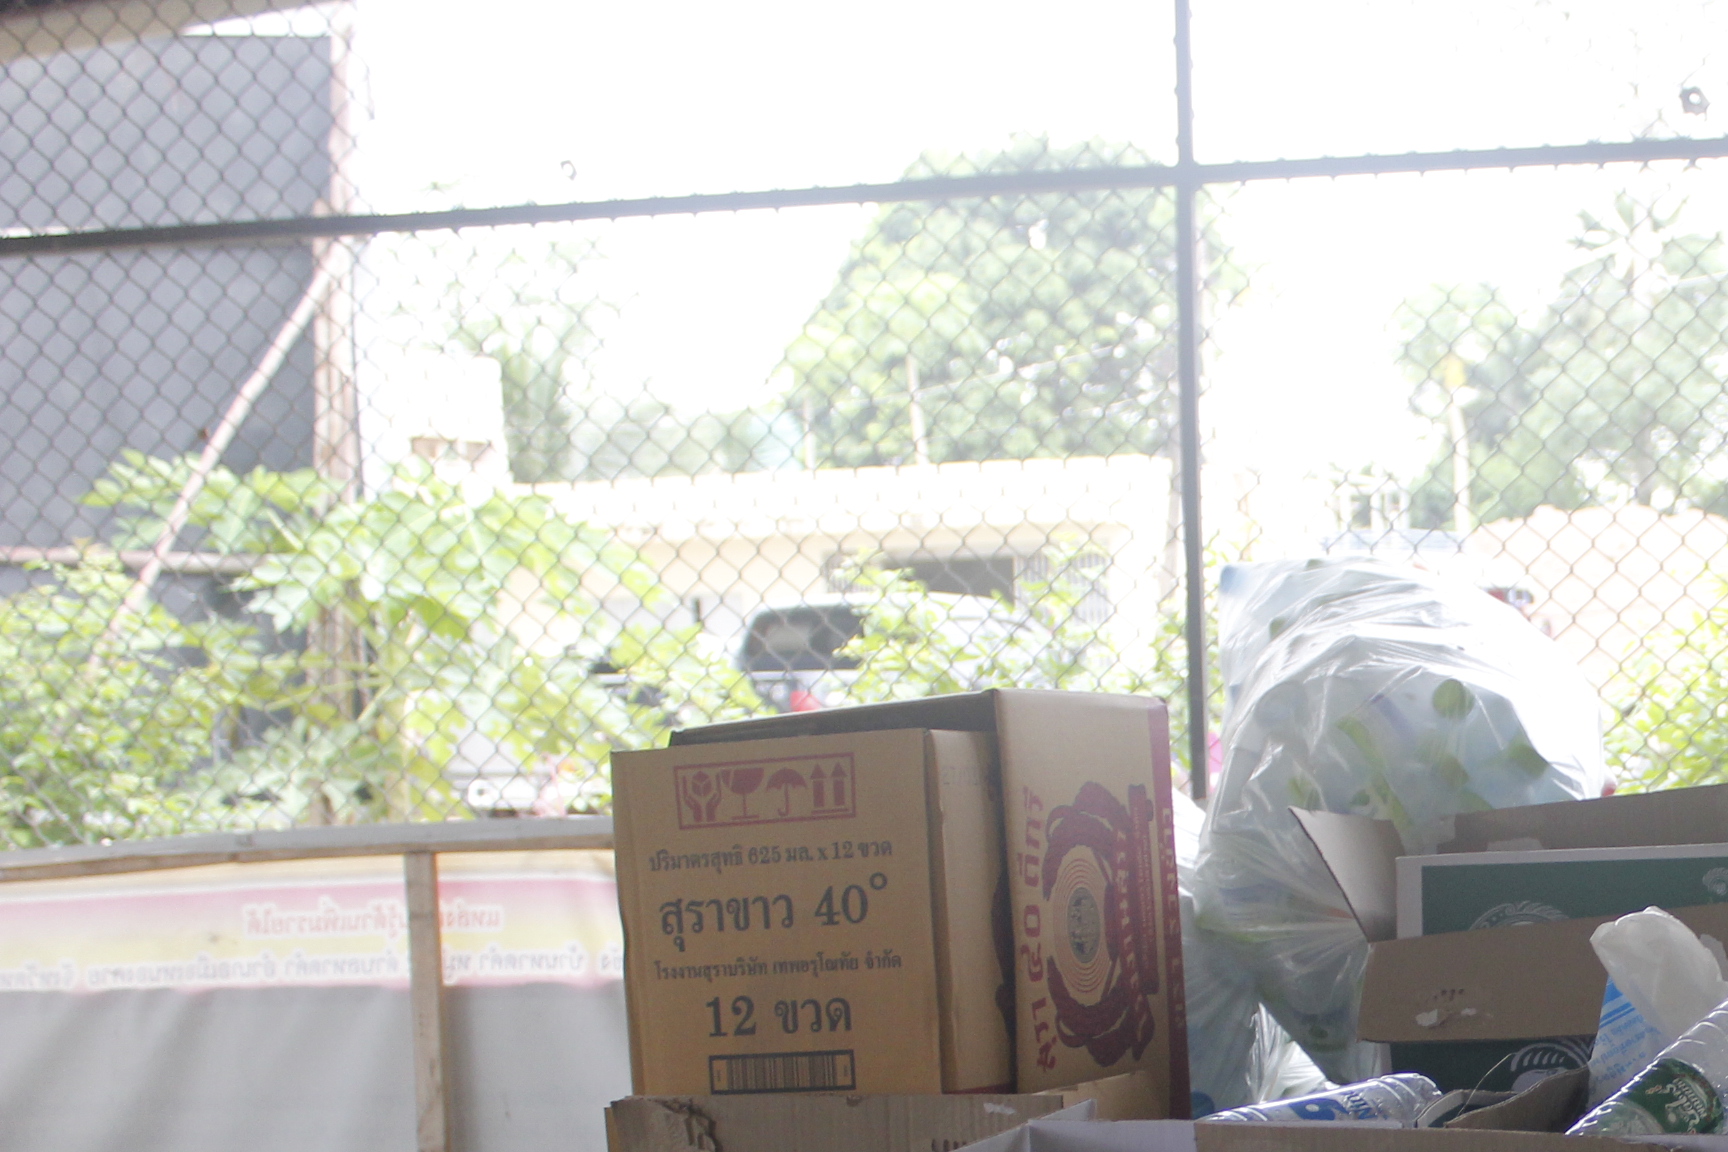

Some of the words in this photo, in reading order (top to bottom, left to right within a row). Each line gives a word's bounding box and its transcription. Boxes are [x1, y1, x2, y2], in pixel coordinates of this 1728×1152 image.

[747, 845, 781, 865] 625
[831, 841, 854, 859] 12
[857, 840, 893, 858] ขวด
[659, 894, 794, 952] สุราขาว
[706, 996, 757, 1038] 12
[774, 998, 852, 1034] ขวด
